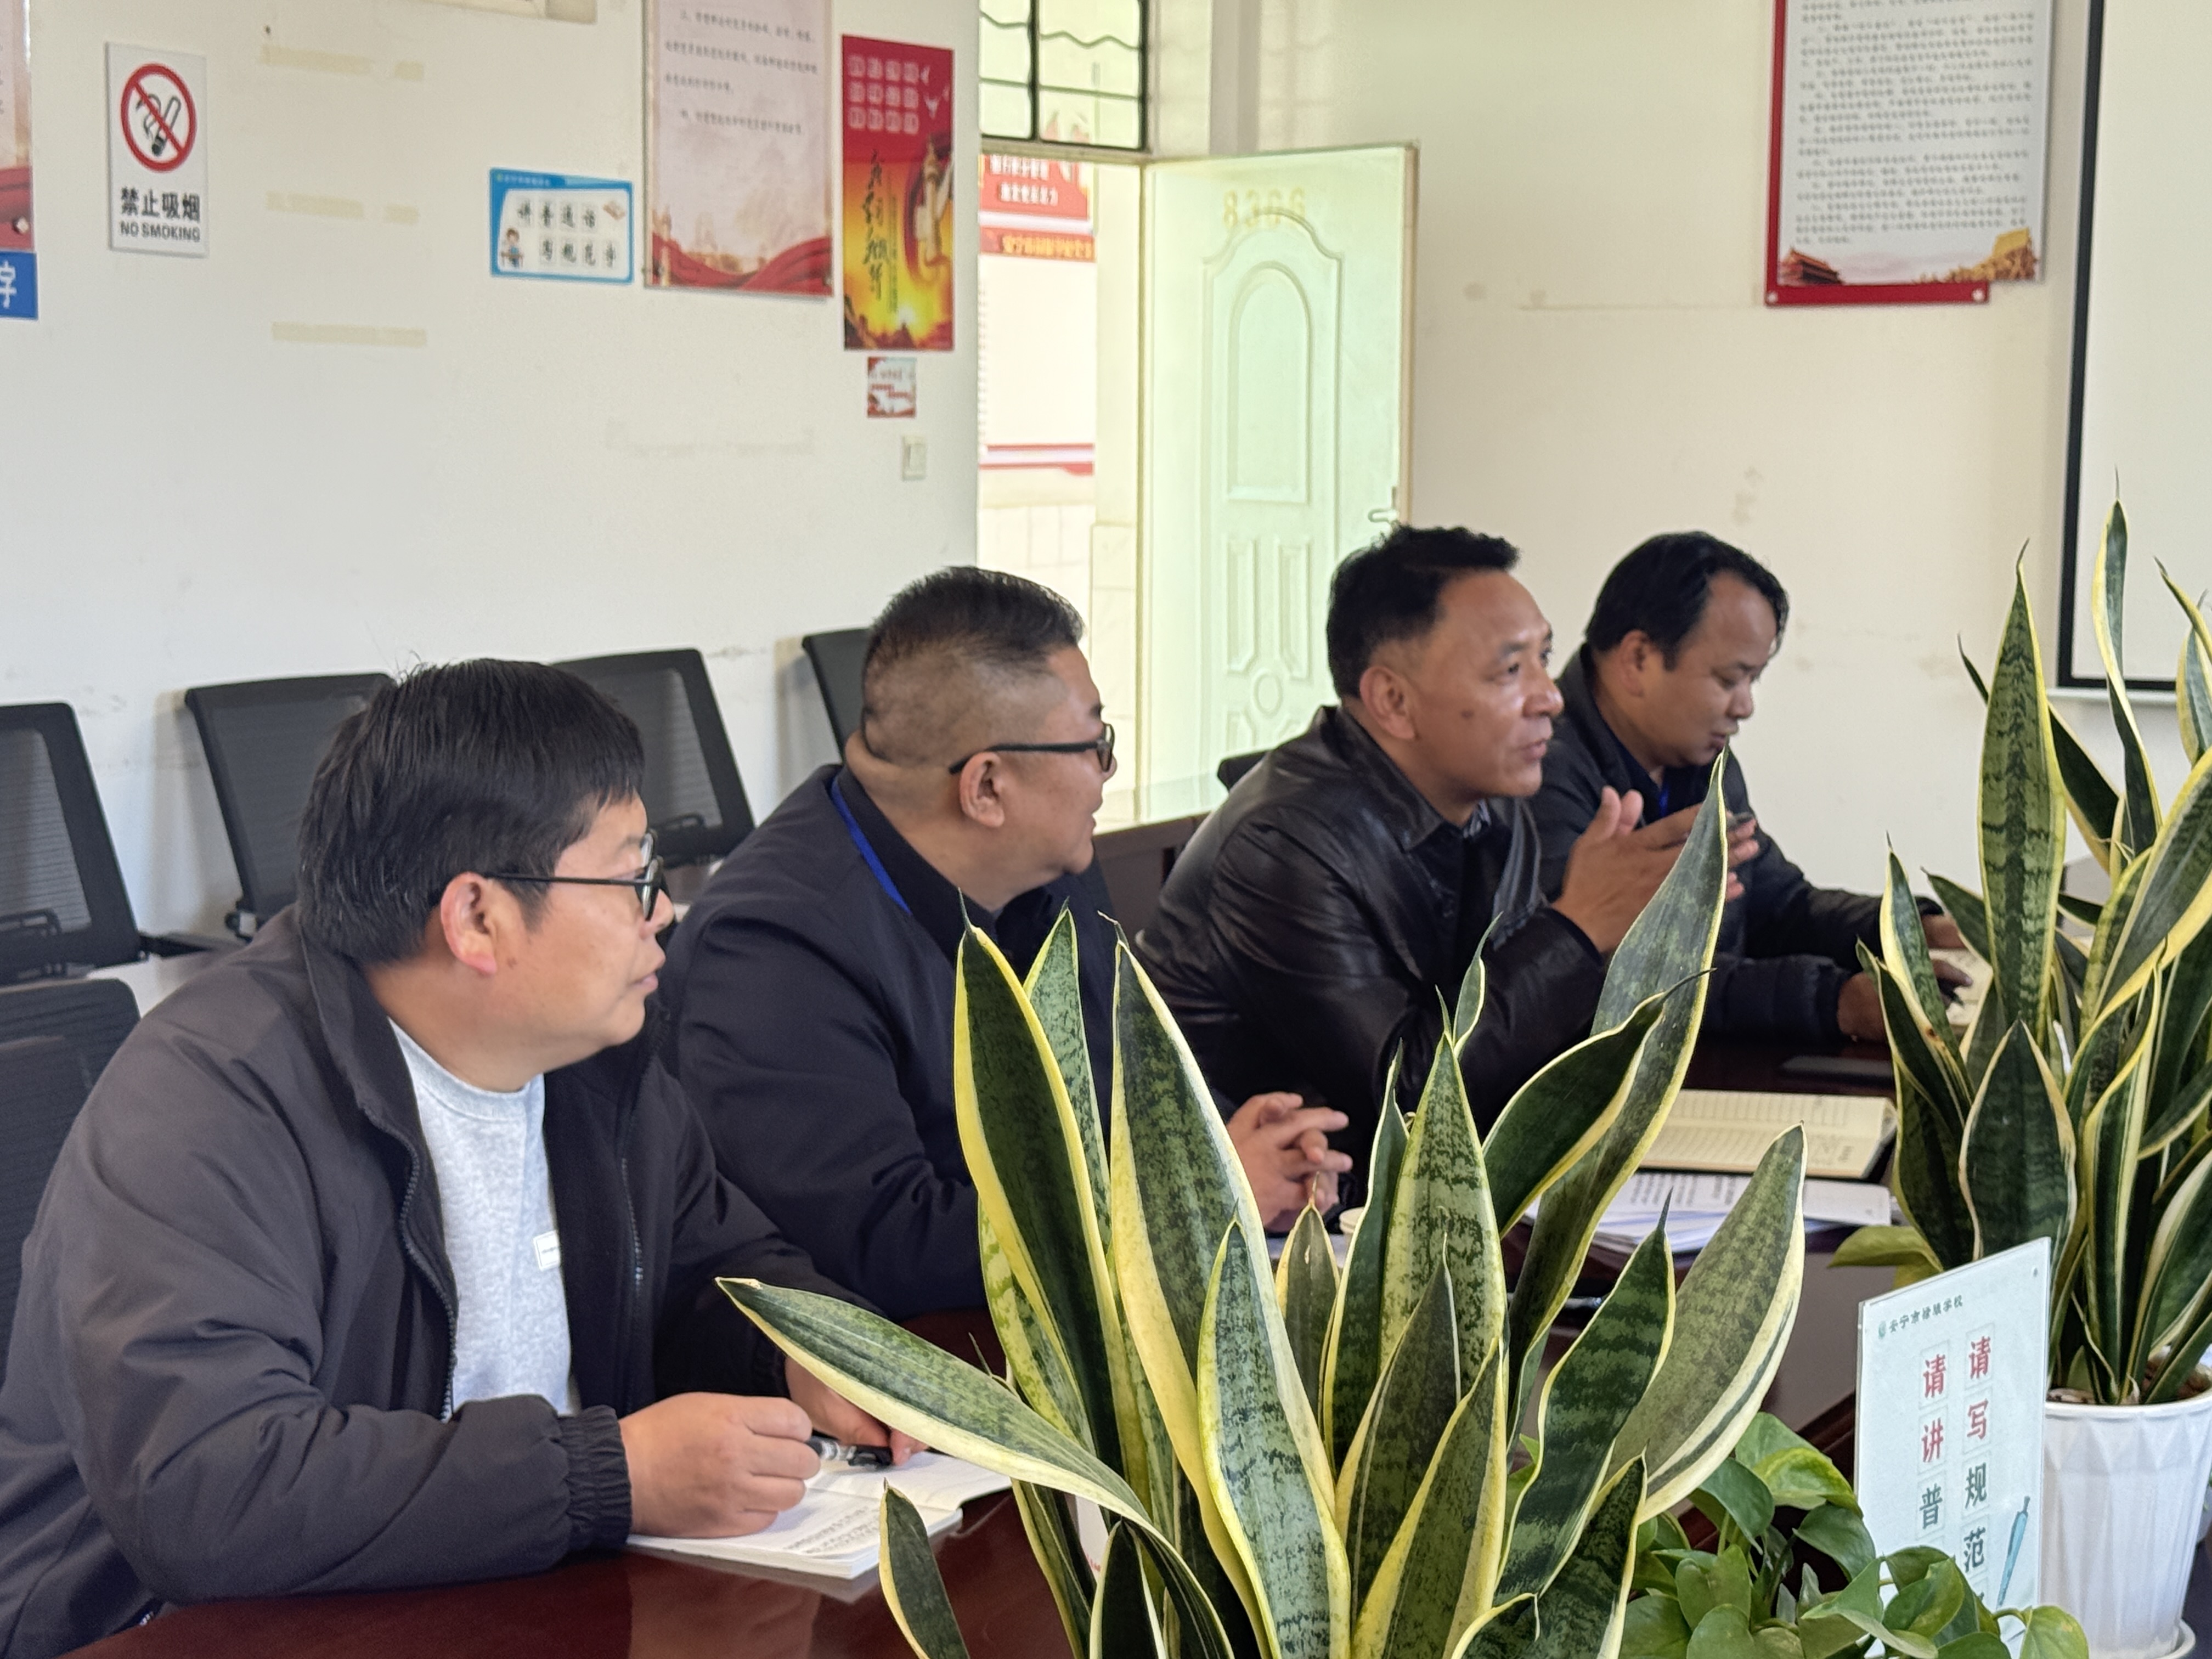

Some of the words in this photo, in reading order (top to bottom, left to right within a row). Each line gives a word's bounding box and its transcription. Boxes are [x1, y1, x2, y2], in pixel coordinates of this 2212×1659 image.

[120, 186, 201, 223] 禁止吸烟
[120, 220, 139, 238] NO
[141, 222, 201, 242] SMOKING
[1963, 1335, 1991, 1602] 请写规范
